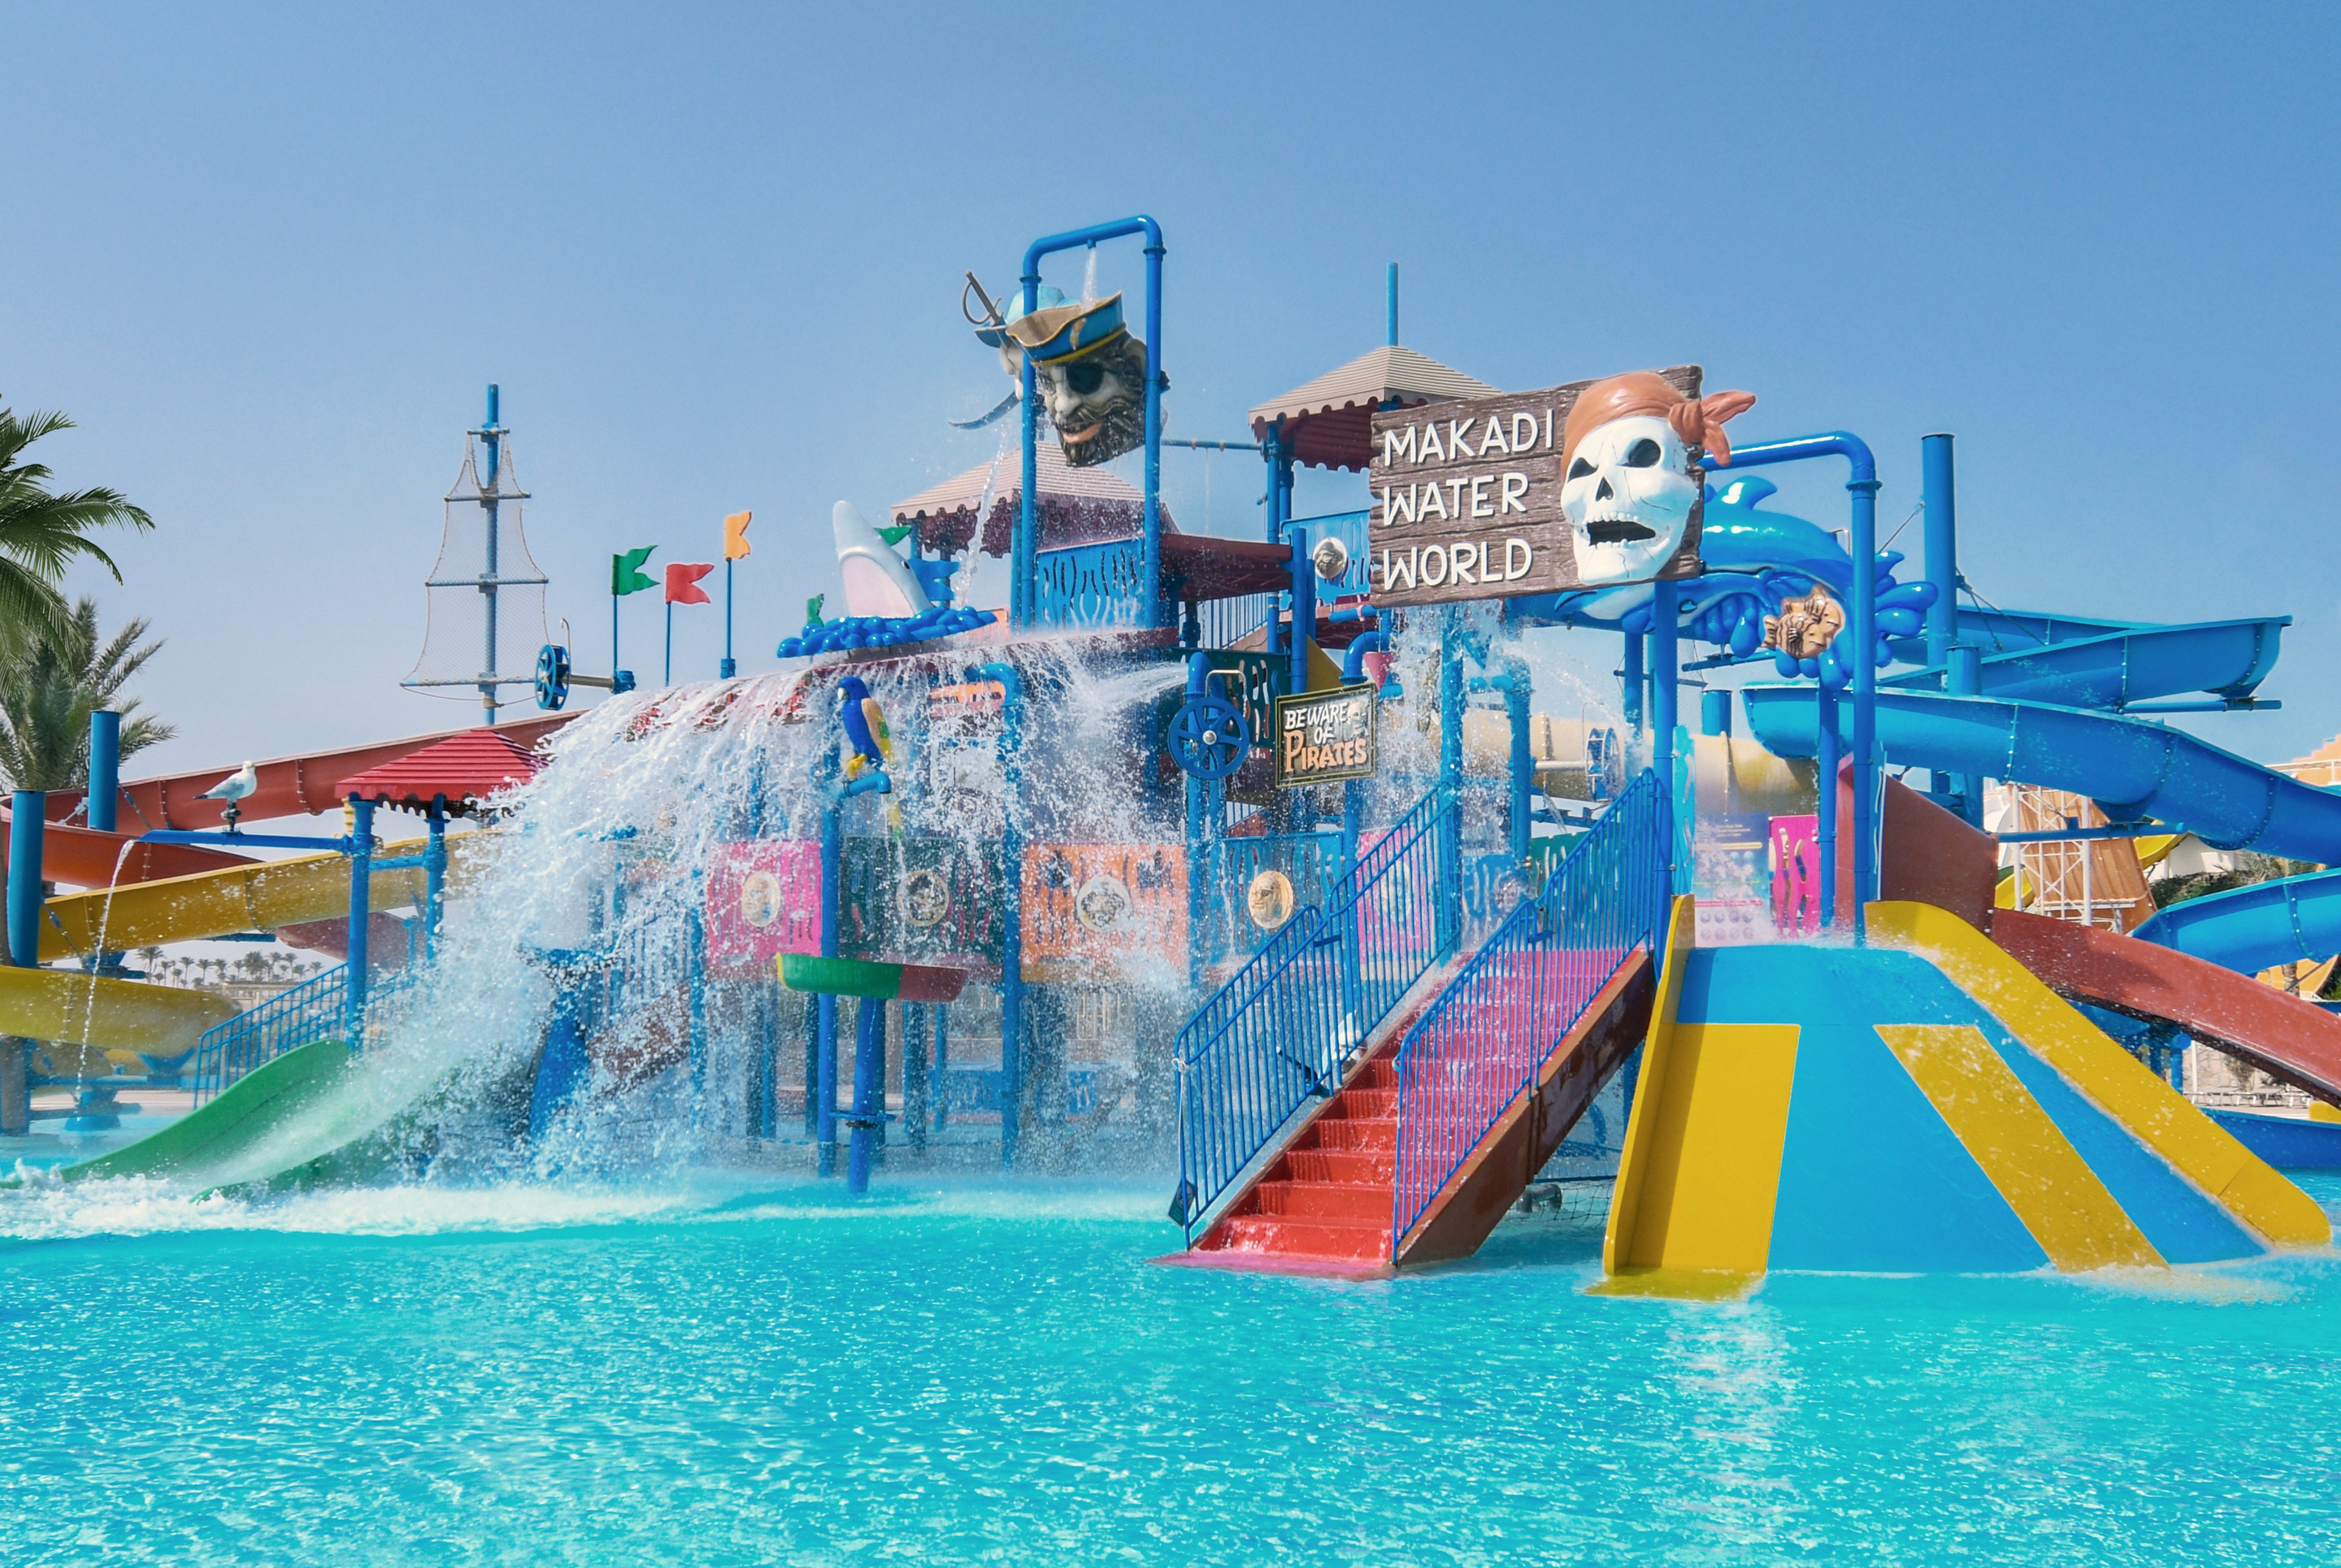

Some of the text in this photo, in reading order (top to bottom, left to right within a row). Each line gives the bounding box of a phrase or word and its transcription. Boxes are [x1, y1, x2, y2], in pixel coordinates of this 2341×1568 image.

[1384, 410, 1553, 466] MAKADI
[1383, 472, 1529, 526] WATER
[1383, 539, 1533, 590] WORLD
[1285, 703, 1348, 729] BEWARE
[1314, 727, 1336, 744] OF
[1283, 730, 1367, 772] PIRATES
